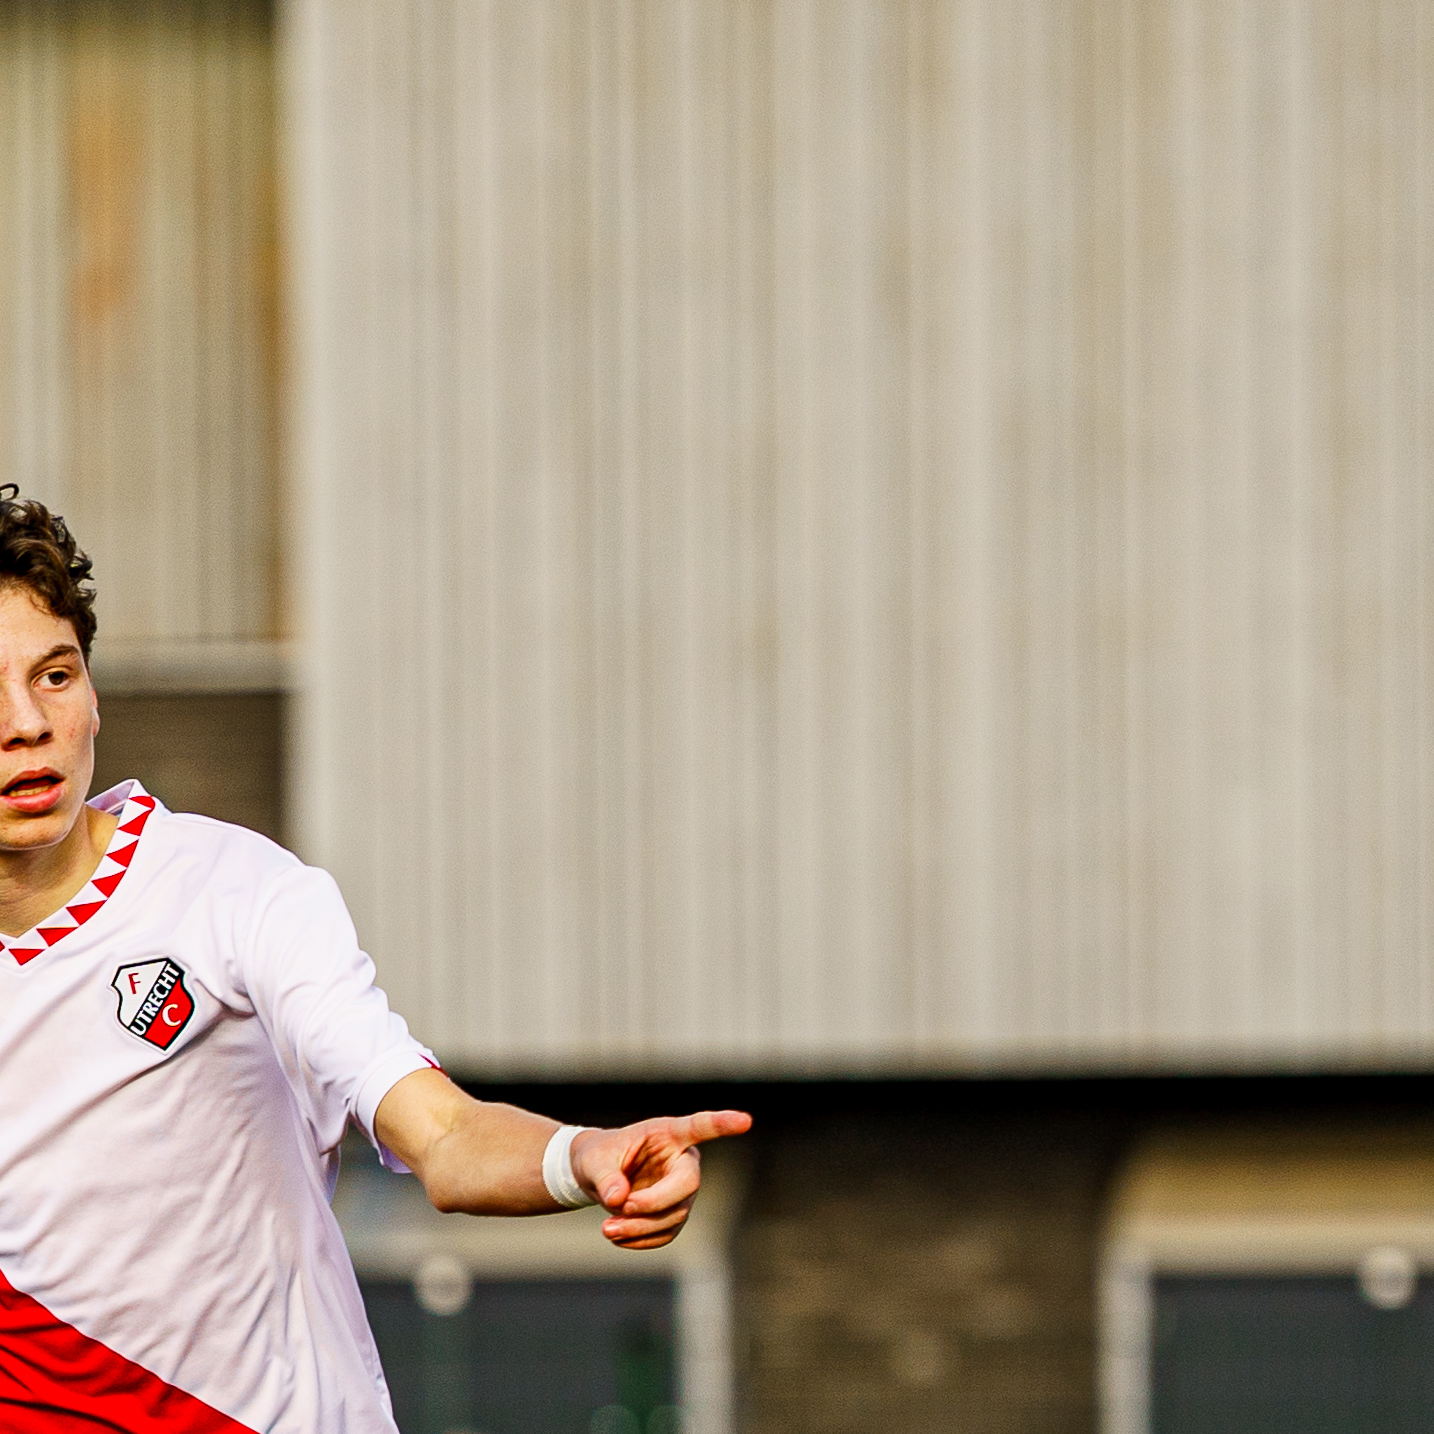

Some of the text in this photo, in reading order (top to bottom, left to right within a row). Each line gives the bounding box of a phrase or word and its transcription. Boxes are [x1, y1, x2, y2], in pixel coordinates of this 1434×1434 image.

[128, 972, 141, 995] F
[130, 963, 179, 1036] UTRECHT
[162, 1003, 182, 1027] C
